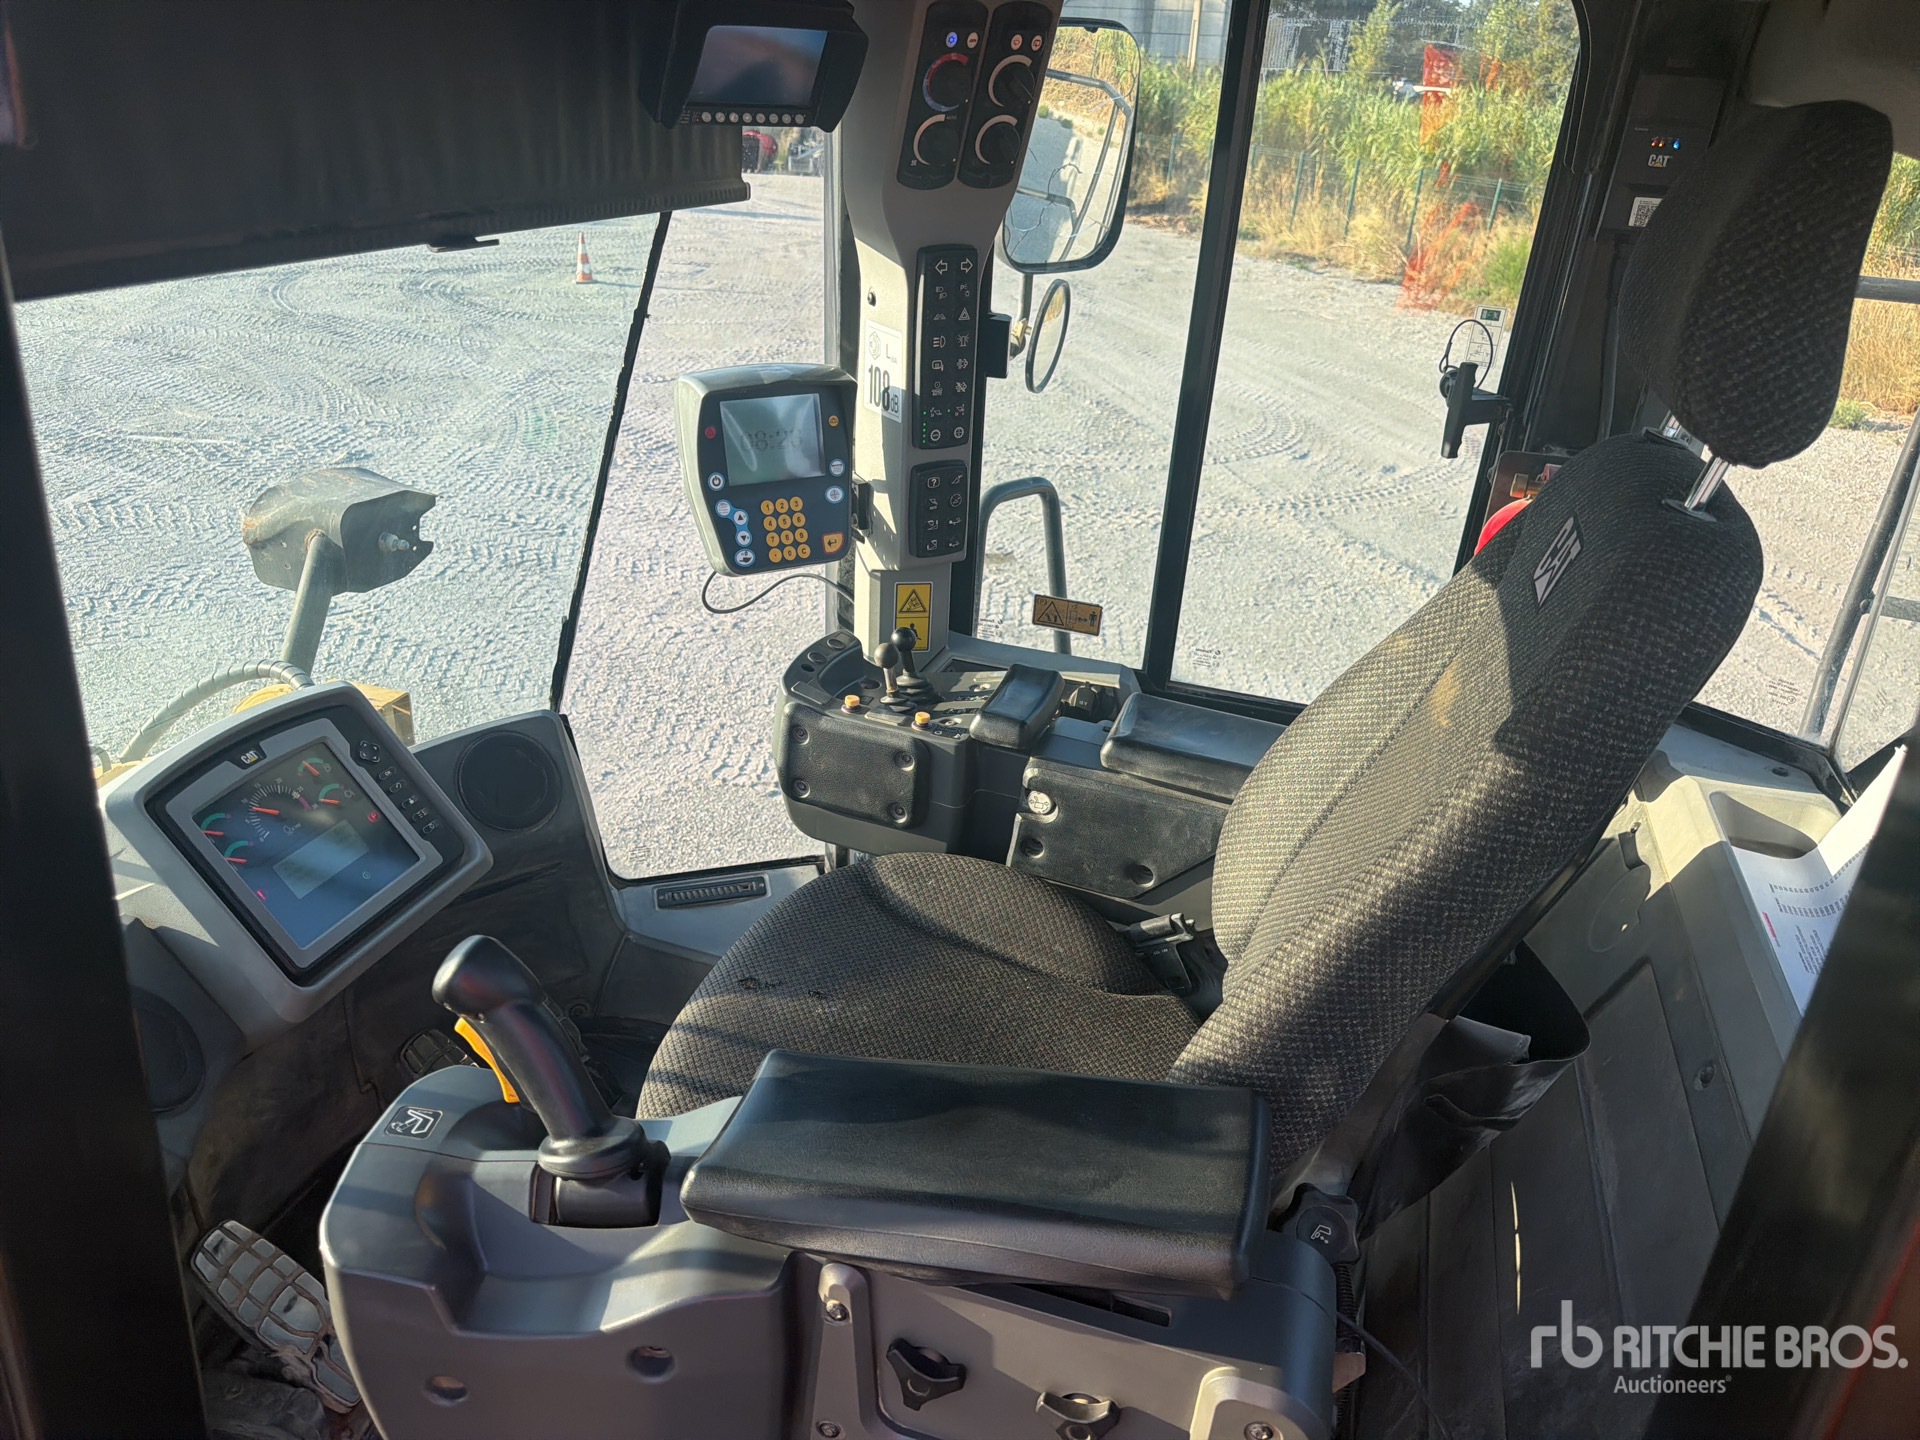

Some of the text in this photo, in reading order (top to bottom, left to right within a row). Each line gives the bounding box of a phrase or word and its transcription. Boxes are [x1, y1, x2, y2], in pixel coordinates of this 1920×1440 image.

[1647, 154, 1670, 168] CAT
[868, 364, 899, 414] 108 dB
[240, 750, 259, 764] CAT
